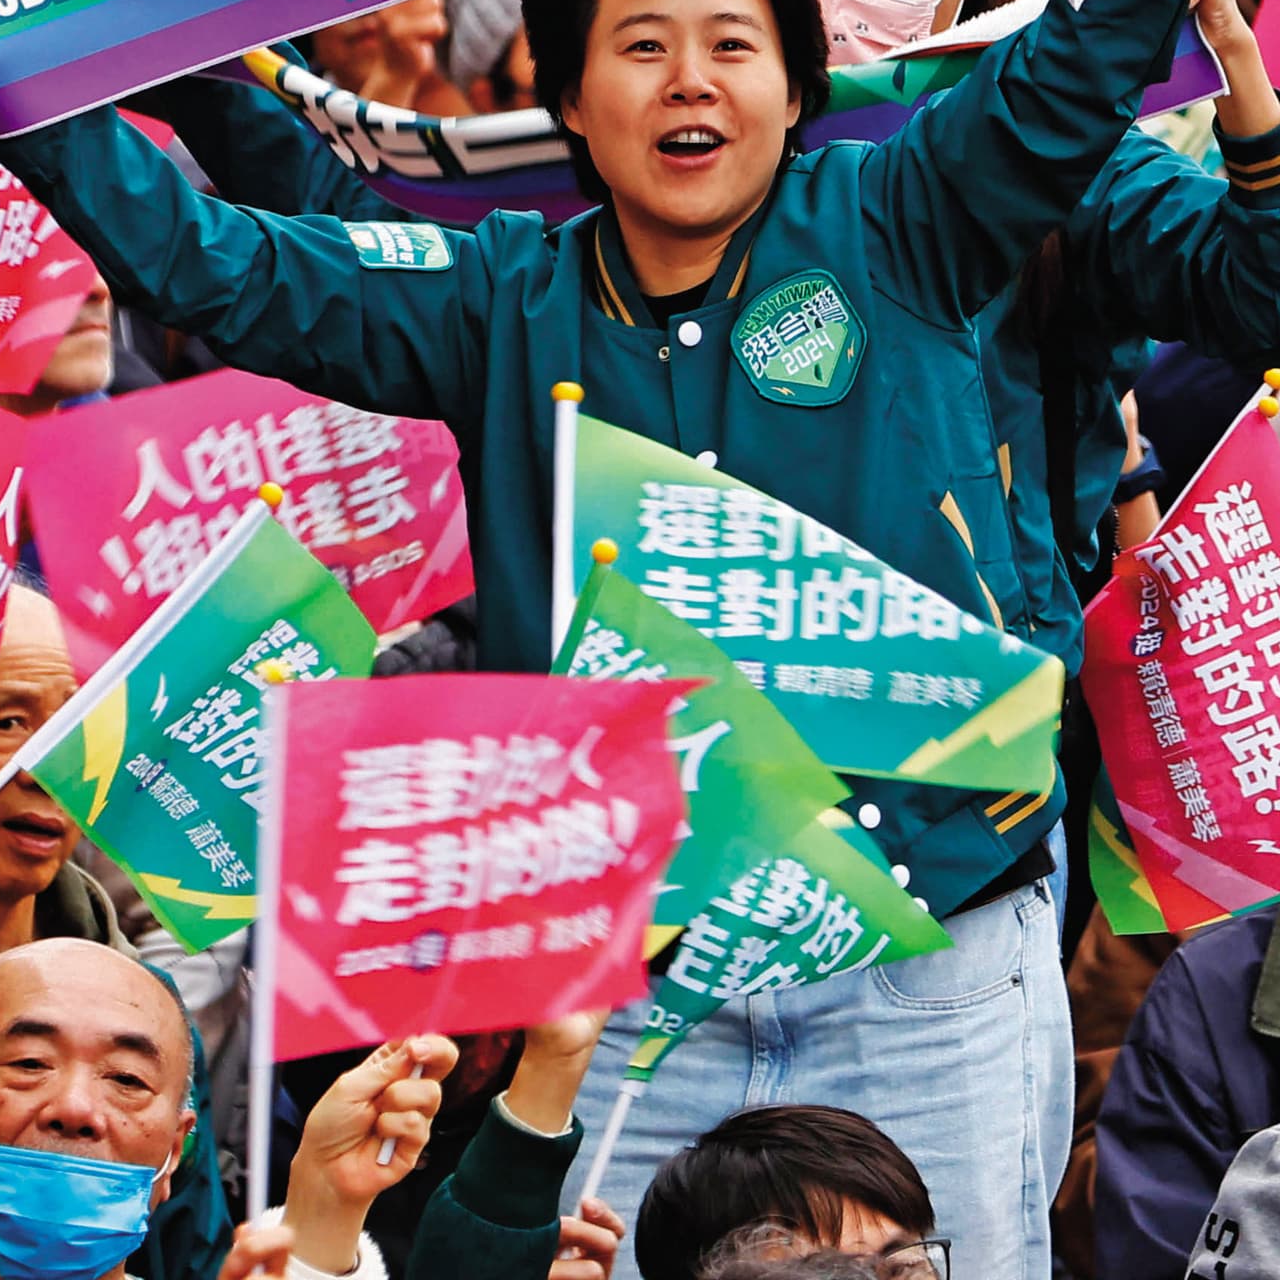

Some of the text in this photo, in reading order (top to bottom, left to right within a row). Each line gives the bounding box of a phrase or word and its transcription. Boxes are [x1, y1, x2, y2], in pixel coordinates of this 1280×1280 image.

[738, 280, 825, 339] TEAM TAIWAN
[741, 285, 849, 380] 挺台灣
[781, 330, 835, 375] 2024
[1131, 631, 1162, 657] 挺
[1136, 659, 1187, 750] 賴清德
[1167, 755, 1223, 841] 蕭美琴
